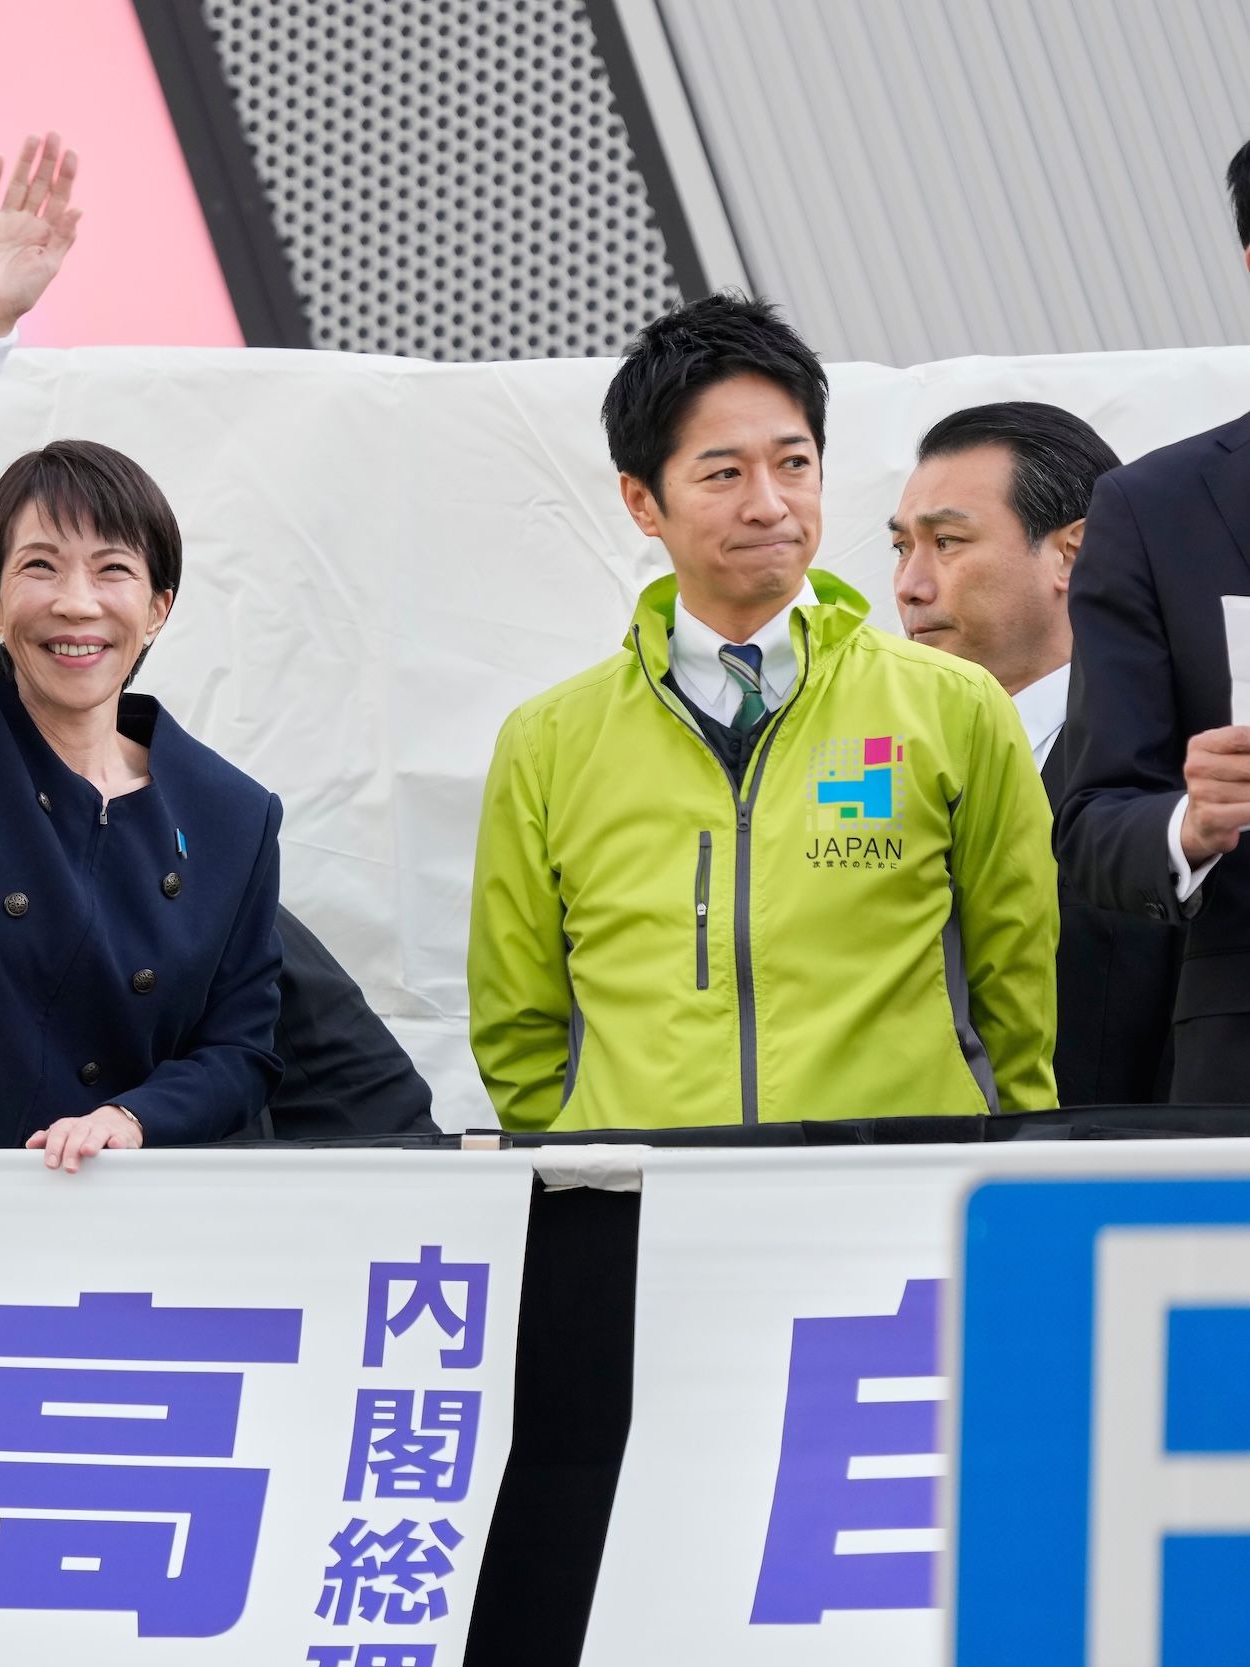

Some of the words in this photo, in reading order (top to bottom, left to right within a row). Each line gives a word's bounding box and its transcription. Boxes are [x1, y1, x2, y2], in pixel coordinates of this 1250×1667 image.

[806, 837, 902, 860] JAPAN
[813, 860, 898, 870] 次世代のために
[306, 1245, 490, 1667] 内閣総
